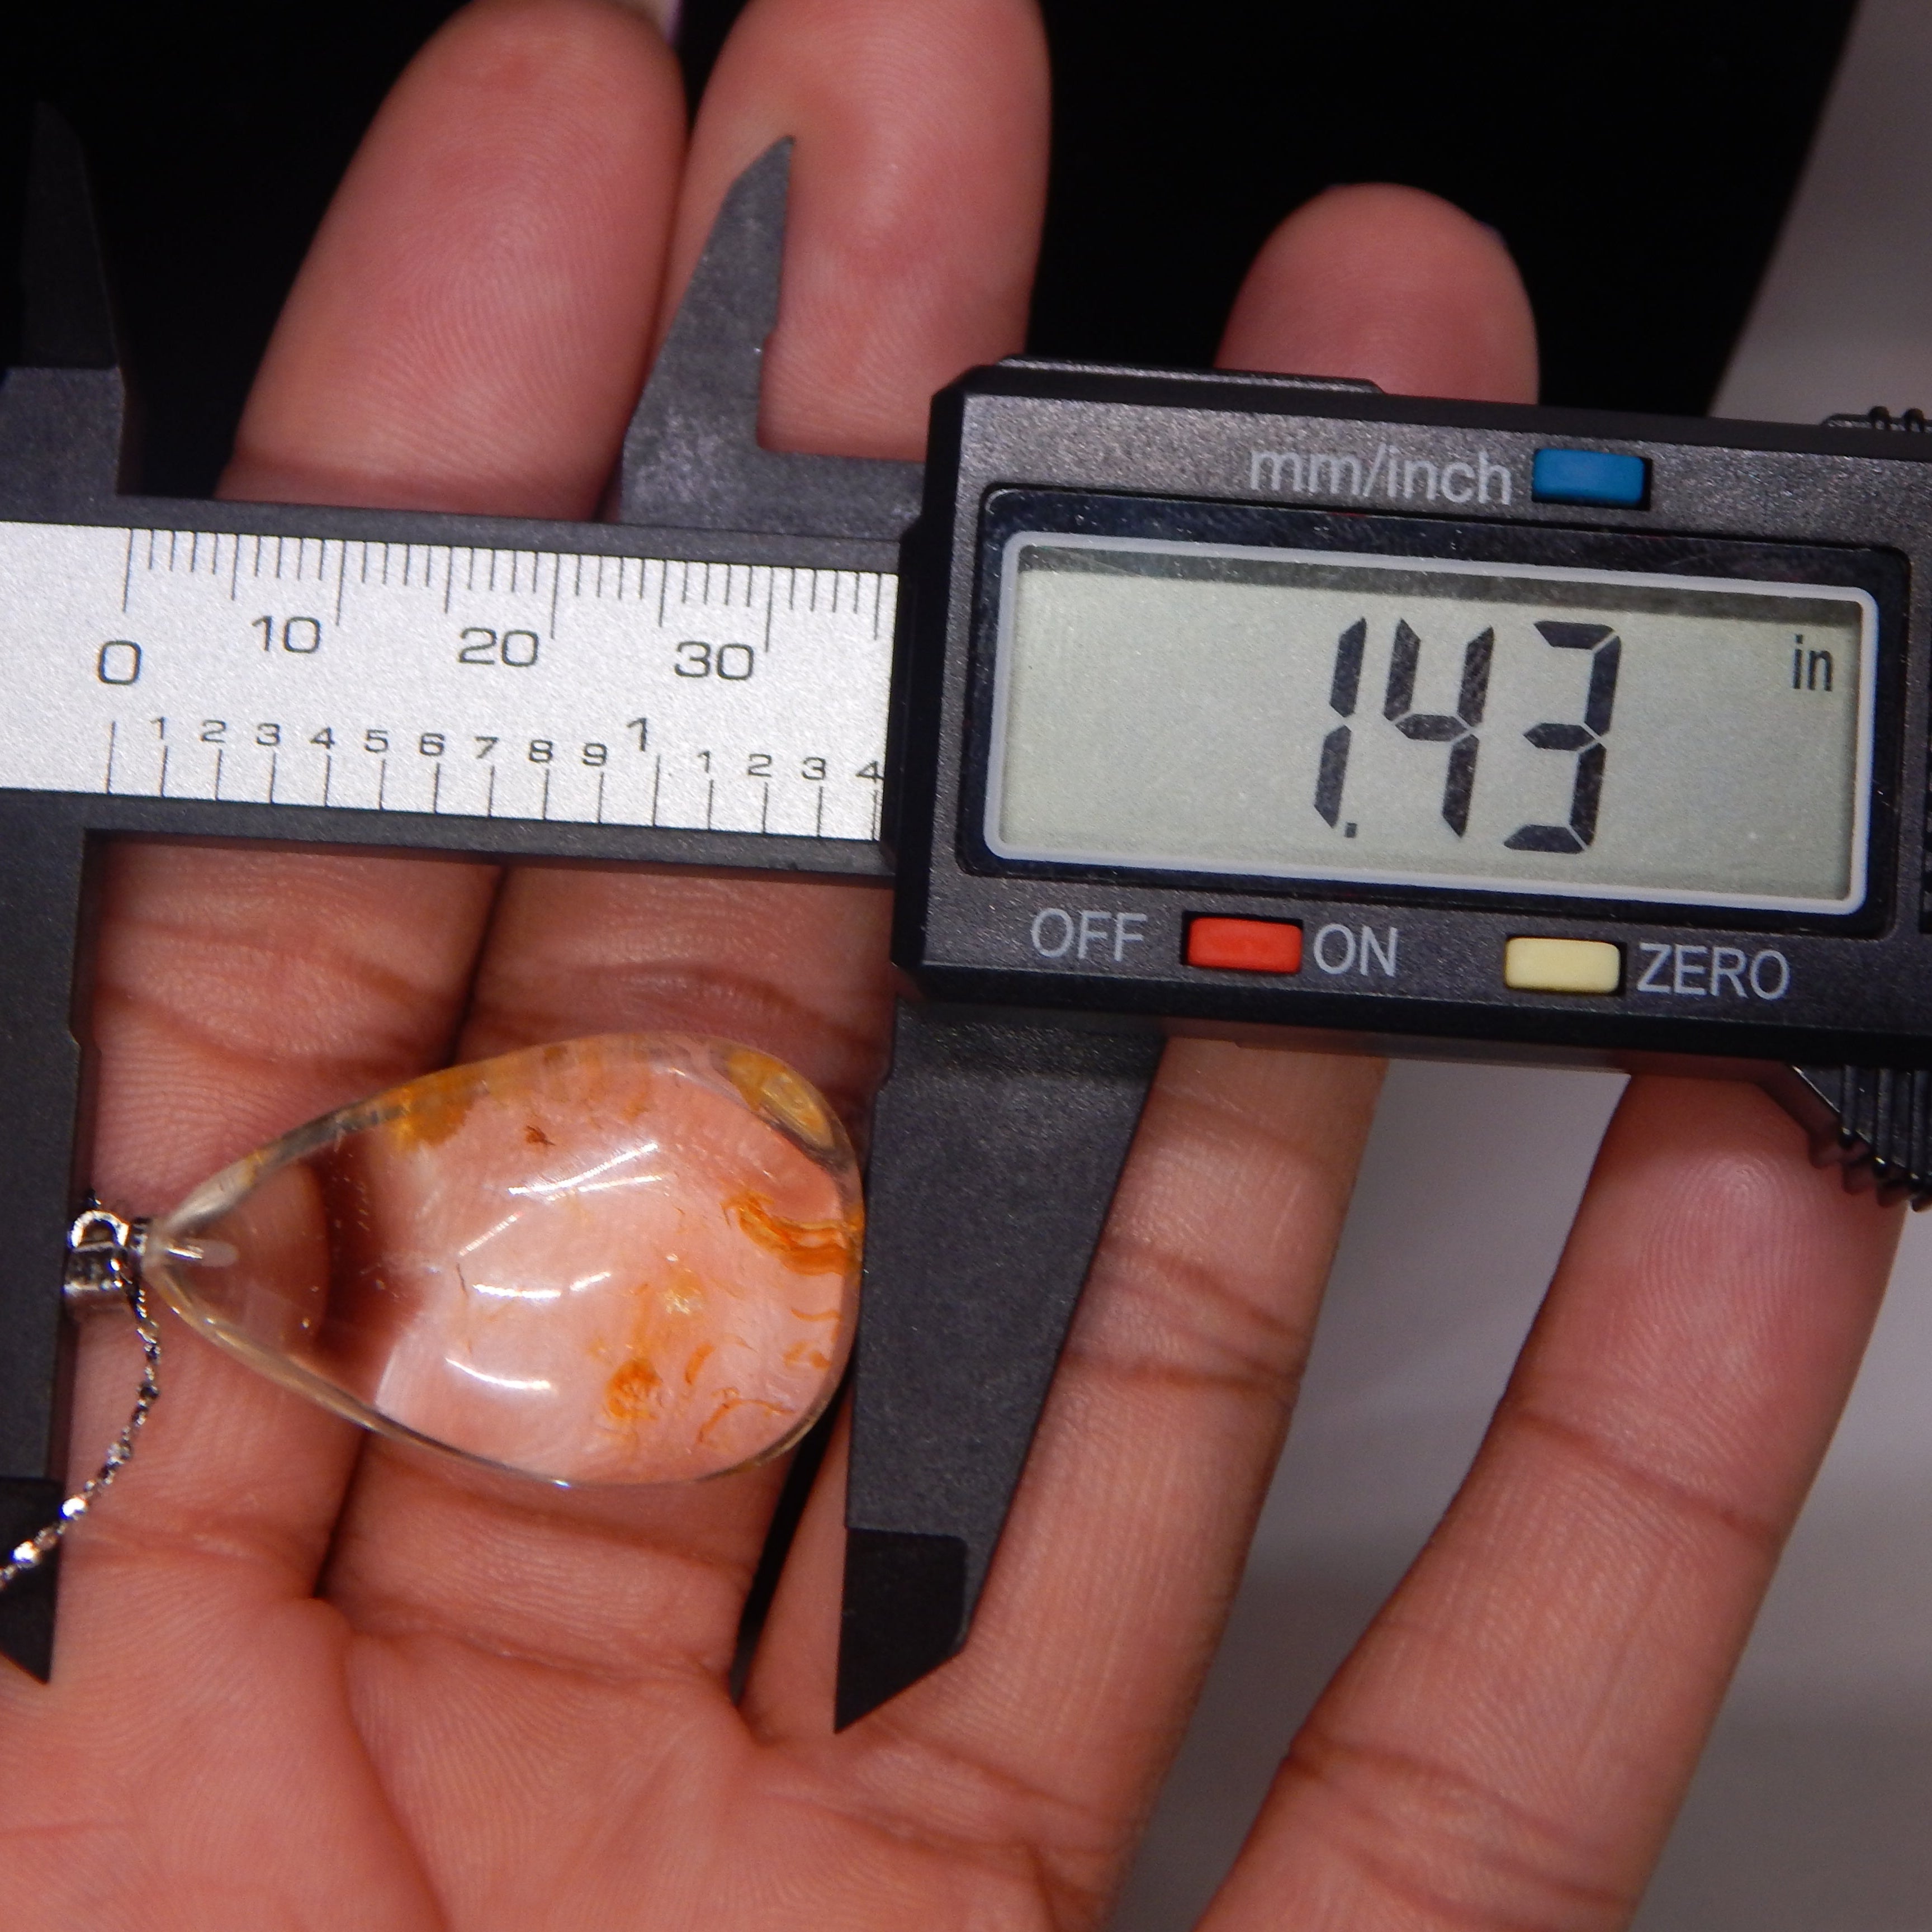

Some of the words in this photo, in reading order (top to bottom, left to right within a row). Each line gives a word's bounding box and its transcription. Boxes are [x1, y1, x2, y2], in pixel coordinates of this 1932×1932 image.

[1249, 445, 1512, 505] mm/inch
[97, 640, 141, 685] 0
[252, 616, 321, 654] 10
[458, 627, 539, 667] 20
[674, 641, 755, 680] 30
[1792, 634, 1834, 691] in
[150, 717, 165, 739] 1
[200, 719, 226, 743] 2
[256, 723, 280, 746] 3
[310, 727, 335, 750] 4
[364, 729, 389, 753] 5
[419, 732, 445, 756] 6
[475, 736, 499, 759] 7
[529, 739, 553, 763] 8
[582, 742, 608, 766] 9
[627, 717, 649, 751] 1
[698, 750, 711, 773] 1
[748, 754, 773, 778] 2
[802, 757, 826, 780] 3
[856, 761, 884, 783] 4
[1314, 617, 1622, 854] 1.43
[1030, 908, 1148, 962] OFF
[1313, 923, 1399, 977] ON
[1636, 942, 1789, 1001] ZERO
